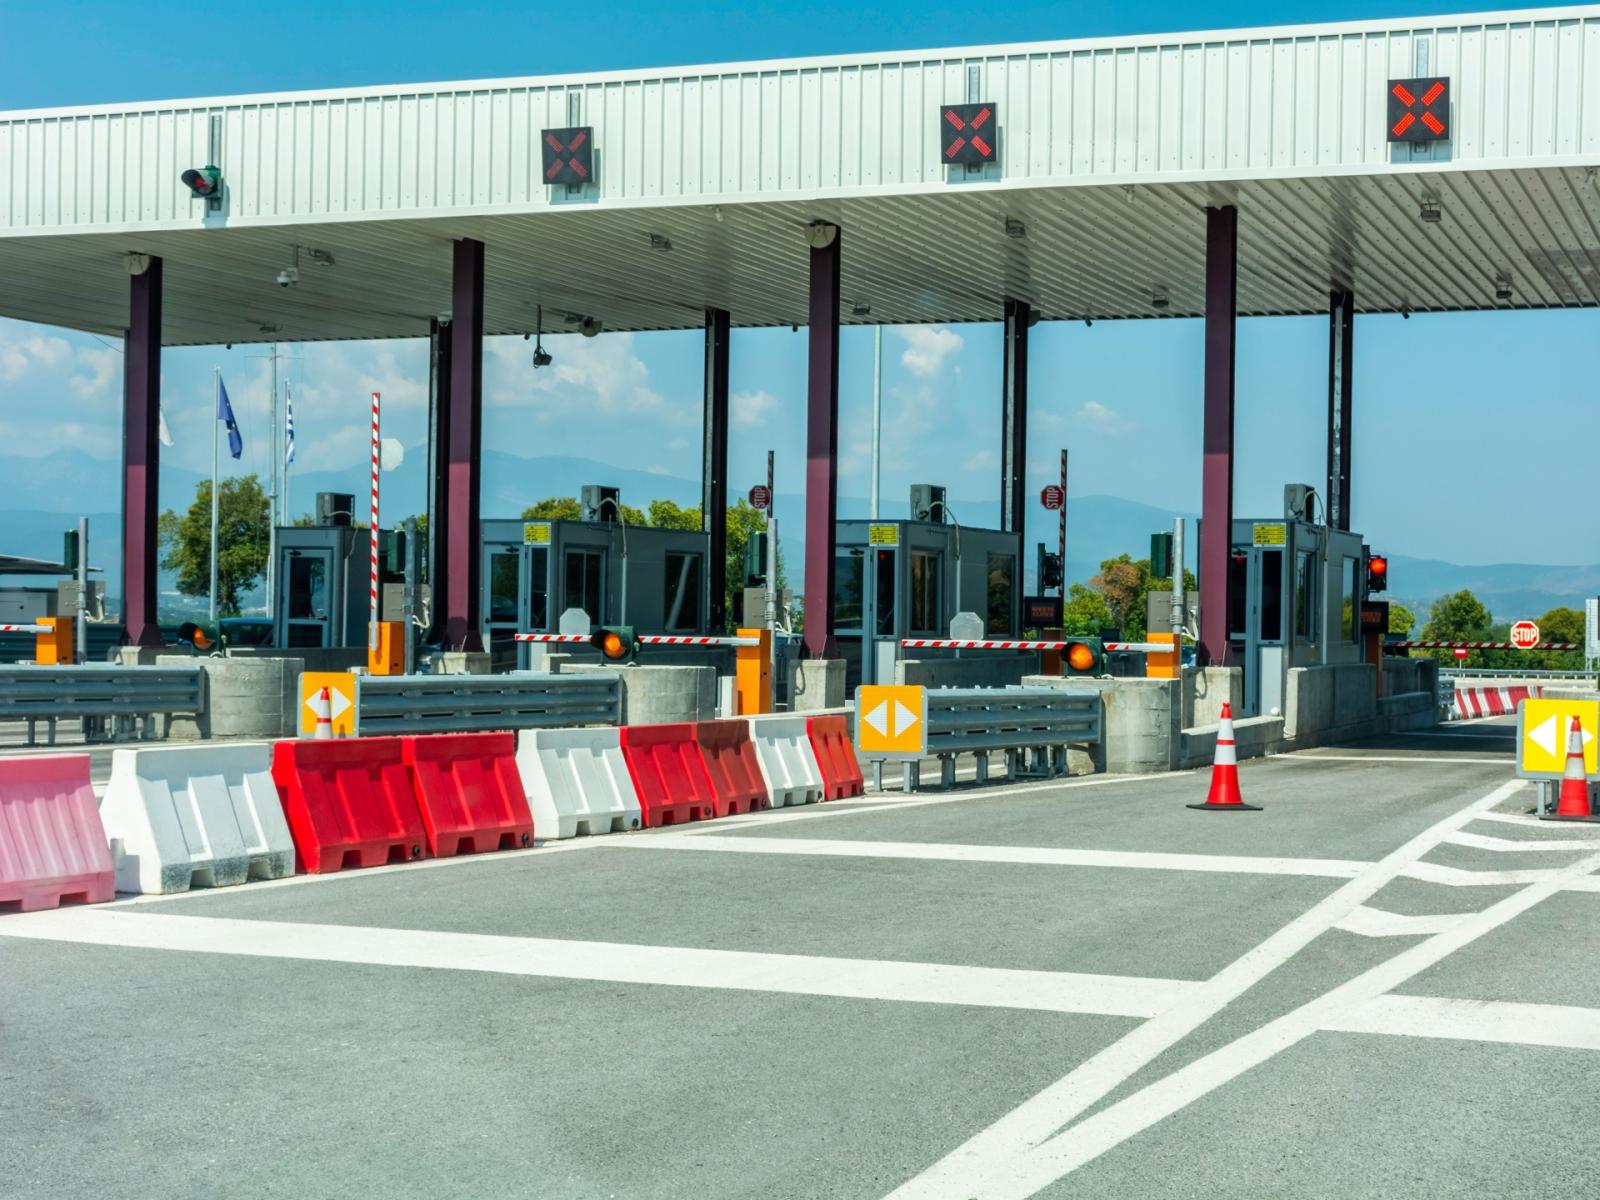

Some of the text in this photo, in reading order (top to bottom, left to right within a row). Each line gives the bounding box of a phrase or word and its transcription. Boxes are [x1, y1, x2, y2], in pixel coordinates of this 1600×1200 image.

[754, 487, 766, 508] STOP
[1046, 487, 1059, 509] STOP
[1513, 627, 1536, 642] STOP
